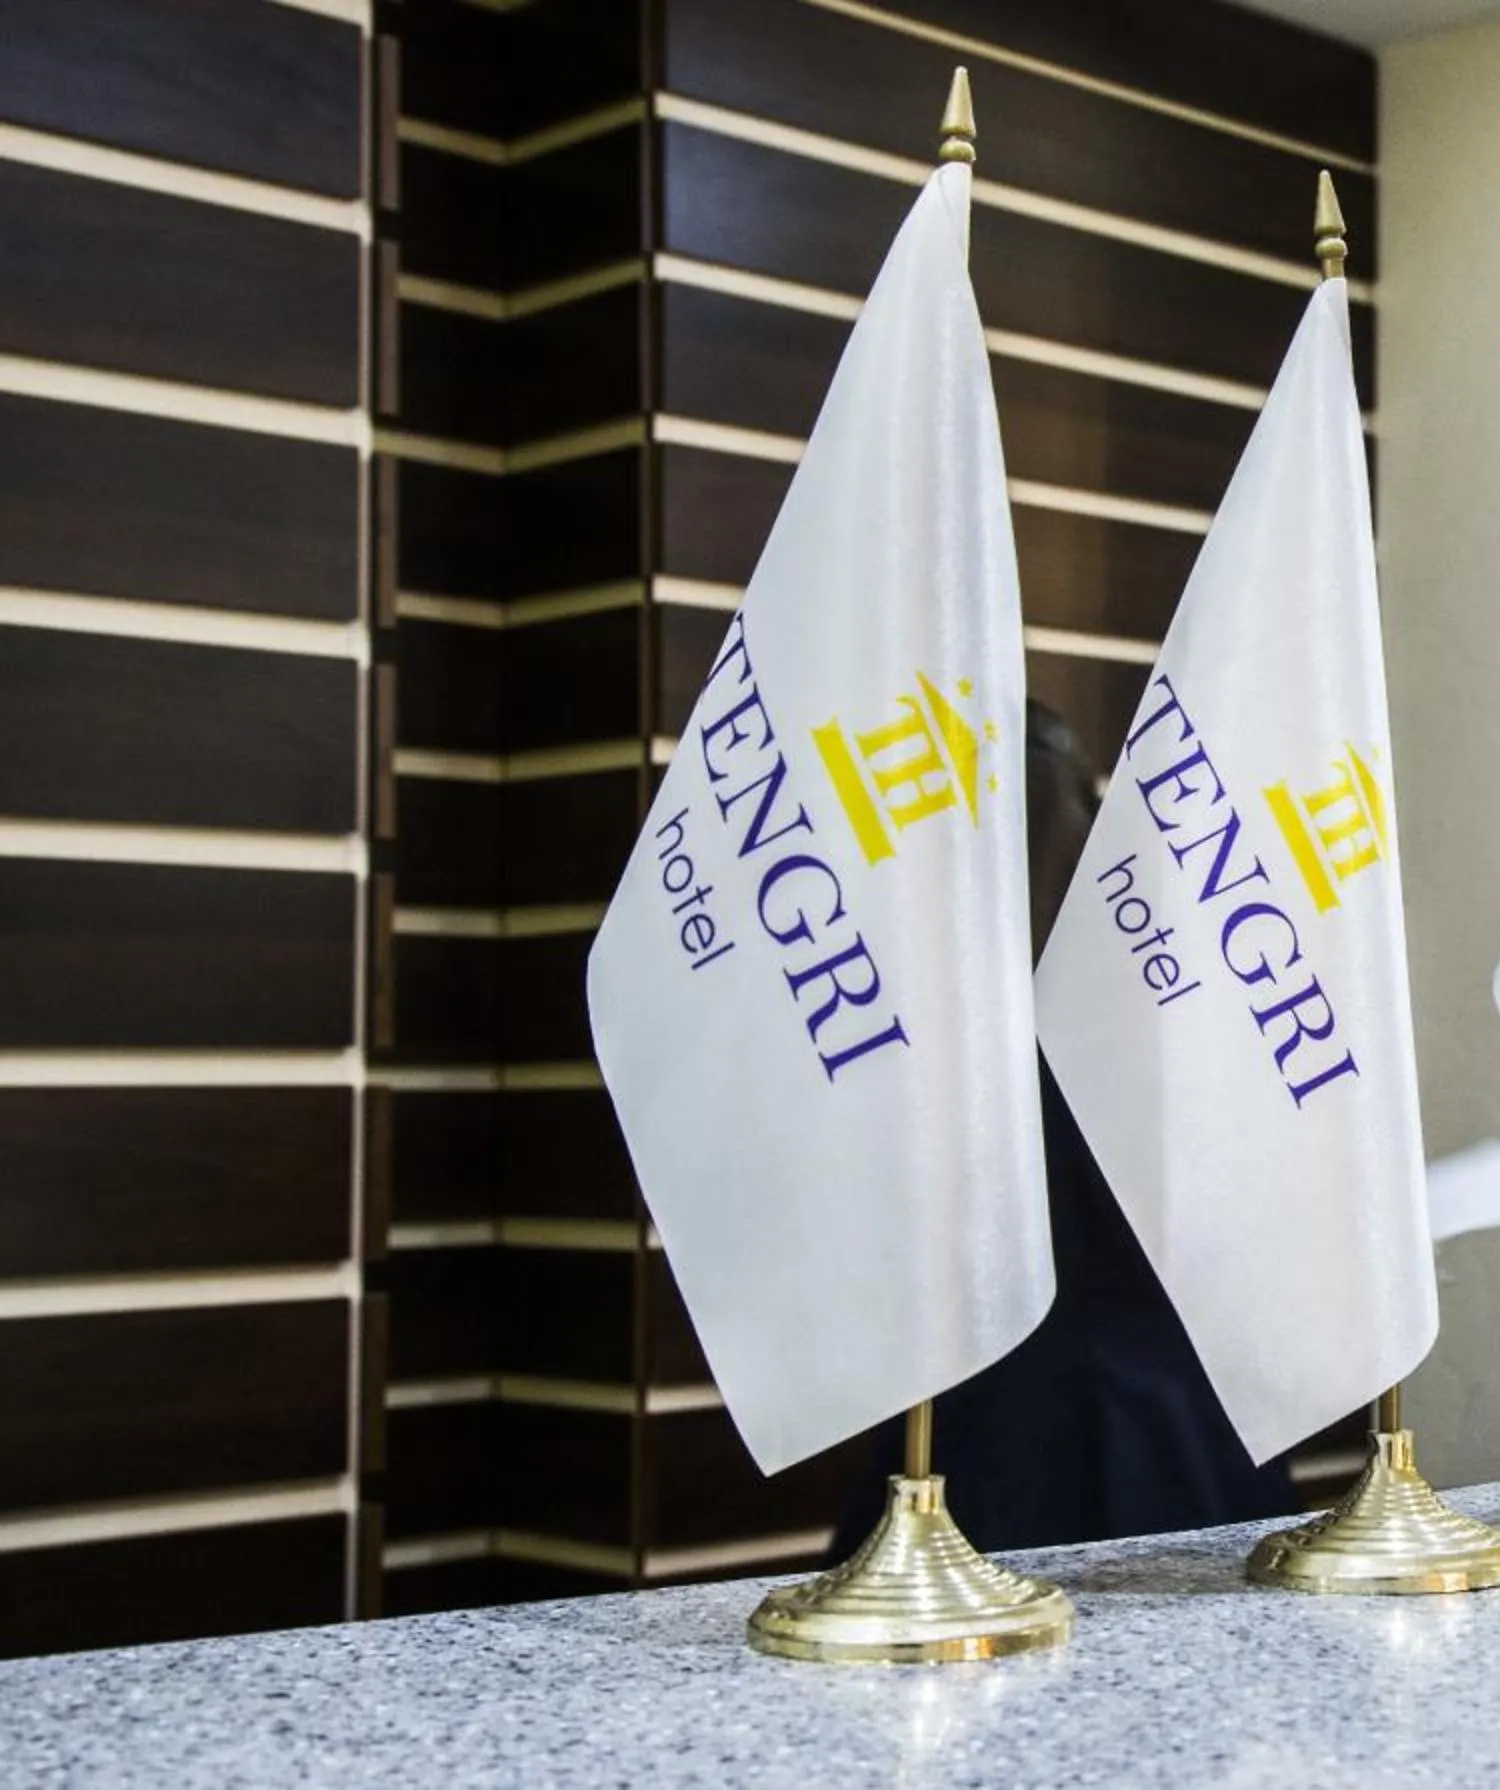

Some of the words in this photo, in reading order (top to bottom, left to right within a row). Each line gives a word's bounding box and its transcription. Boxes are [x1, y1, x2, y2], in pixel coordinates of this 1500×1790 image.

[854, 696, 959, 832] TH
[655, 807, 736, 971] hotel
[700, 611, 910, 1084] TENGRI
[1125, 673, 1360, 1110] TENGRI
[1096, 853, 1202, 1007] hotel
